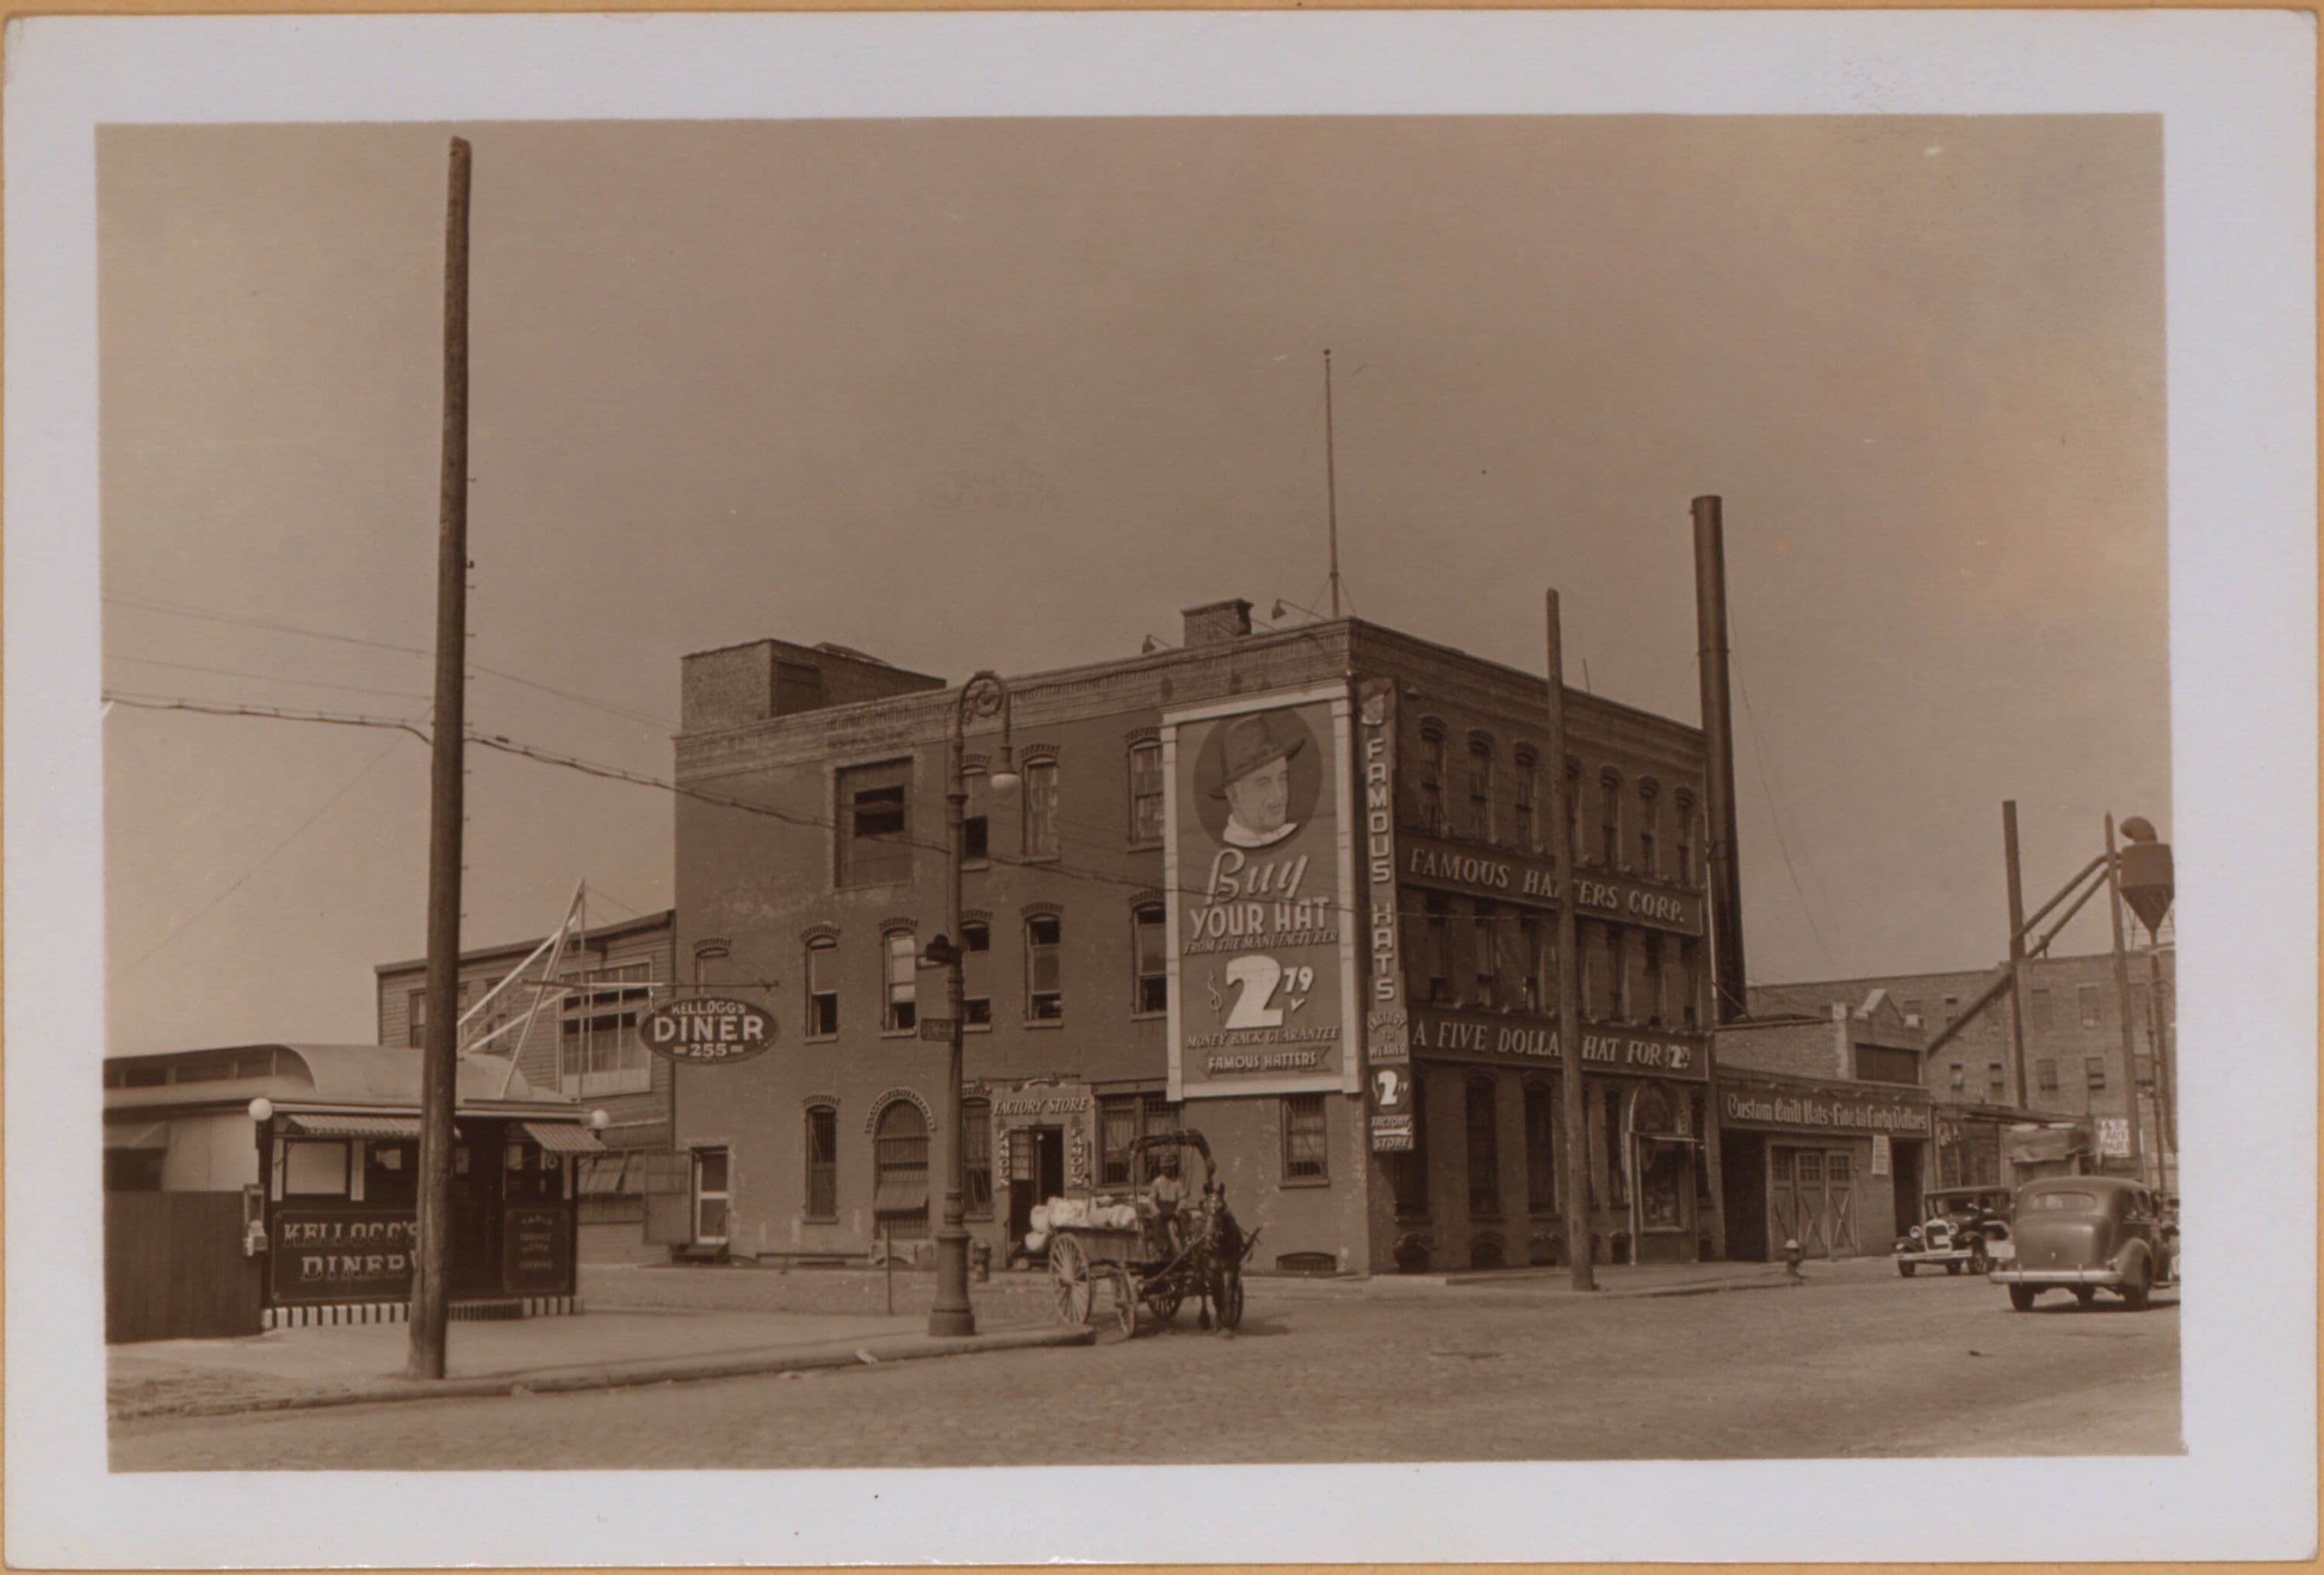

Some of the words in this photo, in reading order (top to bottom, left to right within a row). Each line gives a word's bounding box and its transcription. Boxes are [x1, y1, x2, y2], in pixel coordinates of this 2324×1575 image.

[1366, 737, 1392, 884] FAMOUS
[1205, 848, 1309, 905] Buy
[1409, 846, 1511, 889] FAMOUS
[1522, 868, 1619, 909] HAERS
[1628, 890, 1685, 923] CORP.
[1189, 901, 1265, 941] YOUR
[1275, 896, 1330, 932] HAT
[1184, 941, 1216, 956] FROM
[1220, 938, 1244, 952] THE
[1244, 930, 1340, 950] MANUFACTURER
[1373, 902, 1395, 1002] HATS
[654, 1015, 764, 1042] DINER
[1186, 1034, 1228, 1049] MONEY
[1231, 1030, 1265, 1046] BACK
[1265, 1027, 1341, 1045] GUARANTEE
[690, 1043, 728, 1058] 255
[1369, 1042, 1407, 1058] WEARER
[1413, 1020, 1427, 1047] A
[1437, 1021, 1487, 1052] FIVE
[1497, 1028, 1562, 1057] DOLLA
[1581, 1035, 1620, 1062] HAT
[1626, 1039, 1662, 1066] FOR
[1208, 1054, 1259, 1073] FAMOUS
[1263, 1051, 1317, 1070] HATTERS
[993, 1099, 1047, 1116] FACTORY
[1047, 1096, 1088, 1114] STORE
[1728, 1093, 1773, 1122] Custom
[1070, 1128, 1085, 1187] FAMOUS
[300, 1254, 406, 1282] DINER
